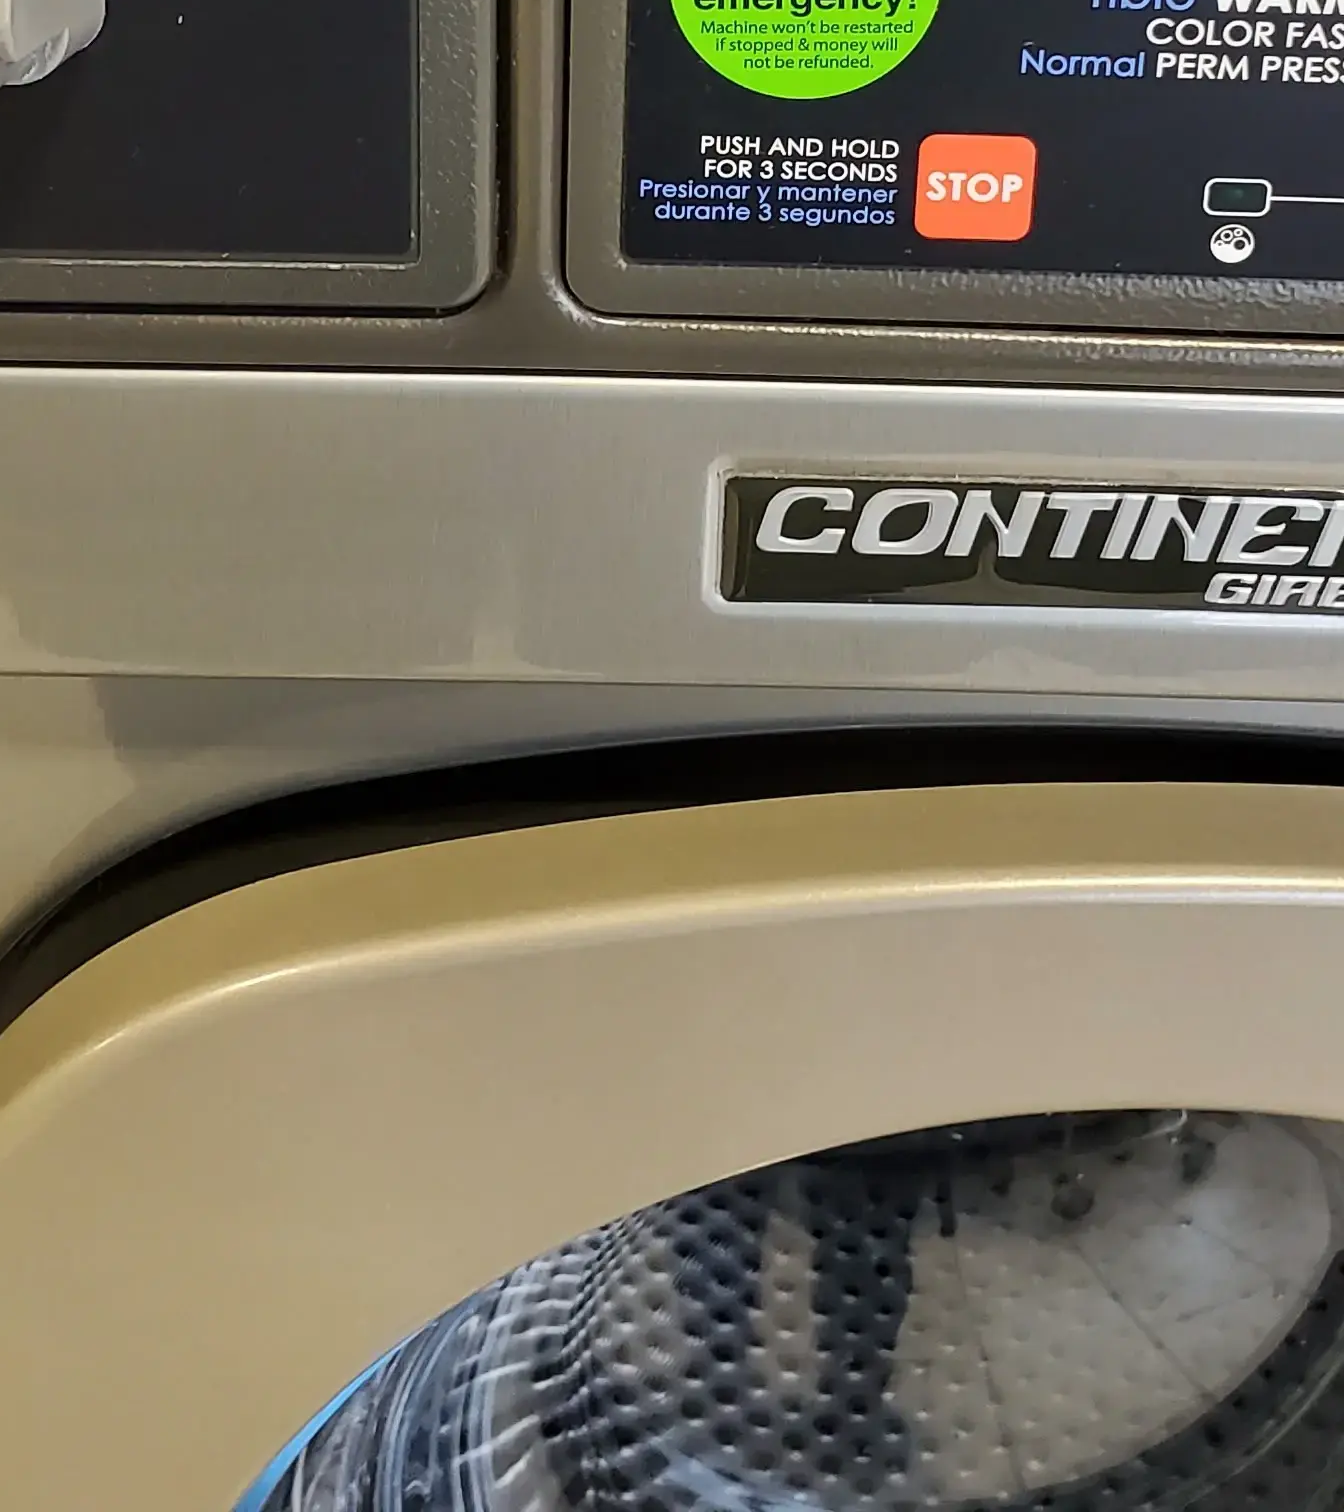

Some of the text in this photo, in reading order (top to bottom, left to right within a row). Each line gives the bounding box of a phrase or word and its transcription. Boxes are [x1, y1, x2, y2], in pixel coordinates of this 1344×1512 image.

[700, 20, 767, 34] Machine
[820, 20, 839, 34] be
[844, 20, 914, 34] restarted
[1146, 18, 1274, 47] COLOR
[716, 38, 898, 54] if stopped & money will
[744, 55, 874, 69] not be refunded.
[1020, 48, 1145, 78] Normal
[1156, 53, 1251, 81] PERM
[700, 135, 900, 159] PUSH AND HOLD
[704, 158, 898, 183] FOR 3 SECONDS
[639, 179, 898, 205] Presionar y mantener
[926, 171, 1023, 204] STOP
[654, 201, 896, 227] durante 3 segundos
